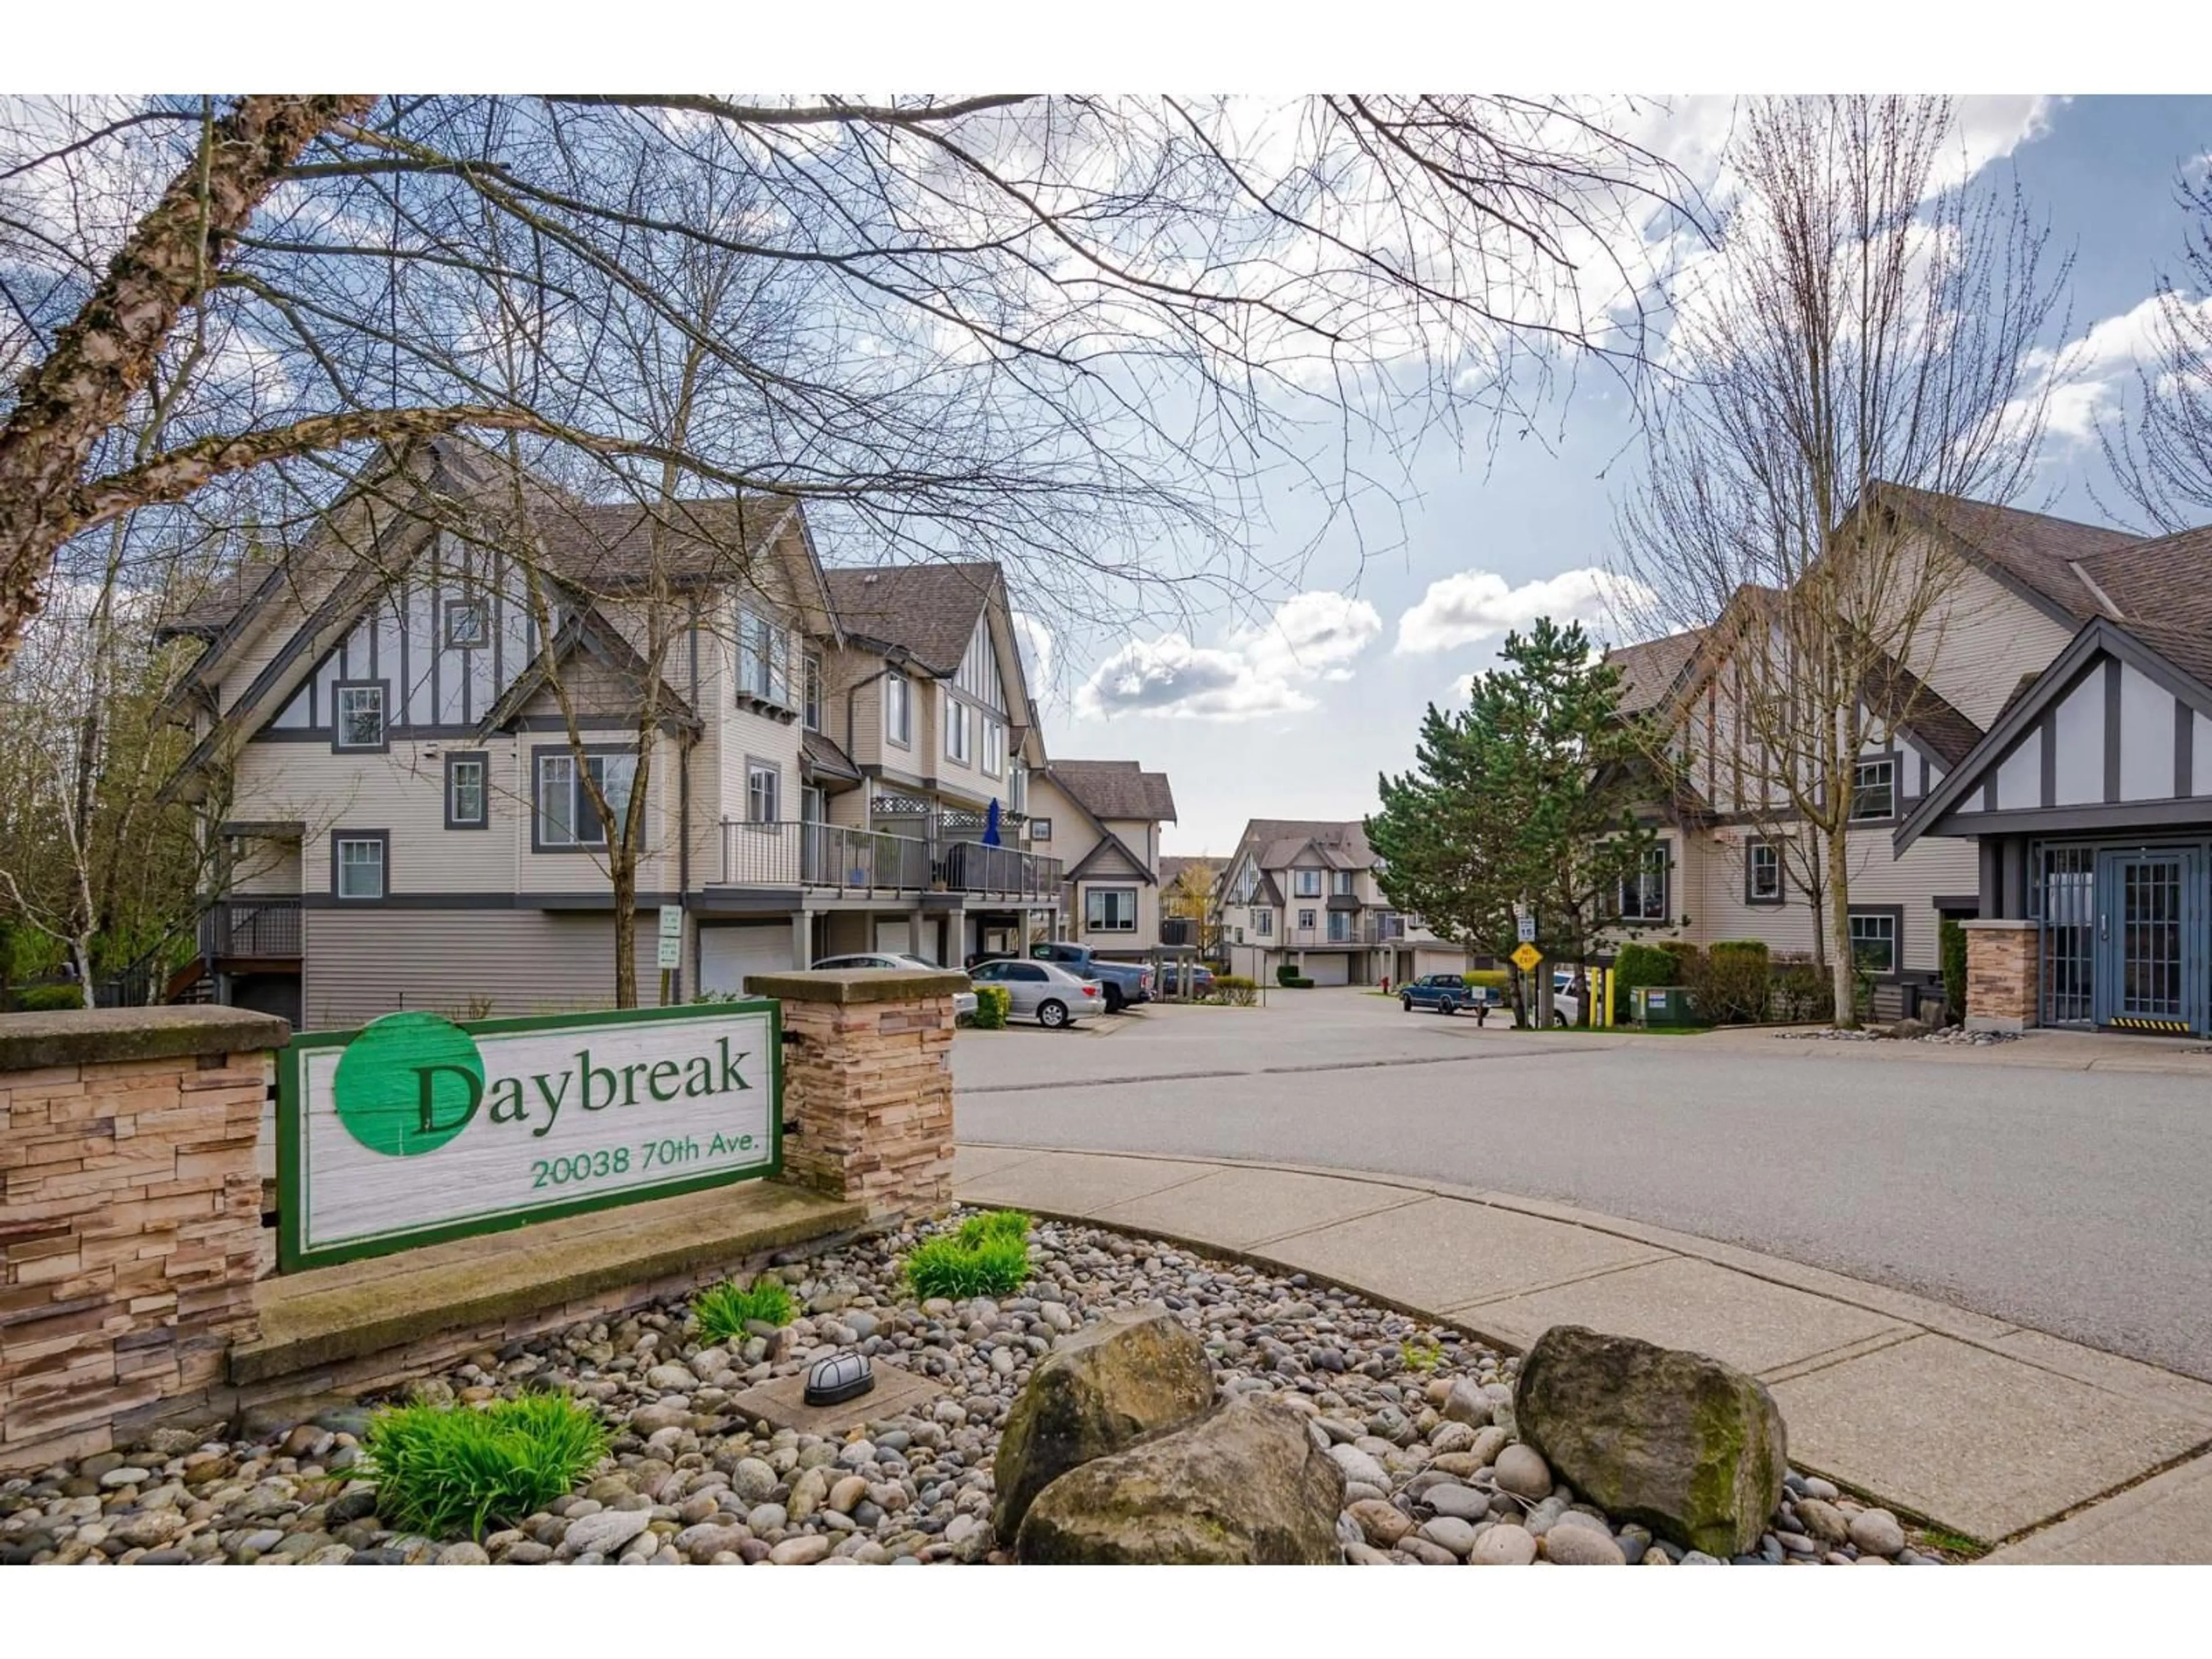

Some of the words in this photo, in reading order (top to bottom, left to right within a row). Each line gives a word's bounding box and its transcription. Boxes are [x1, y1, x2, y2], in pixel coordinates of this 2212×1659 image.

[410, 1036, 753, 1137] Daybreak
[532, 1147, 630, 1189] 20038
[642, 1135, 699, 1169] 70th
[708, 1132, 759, 1157] Ave.
